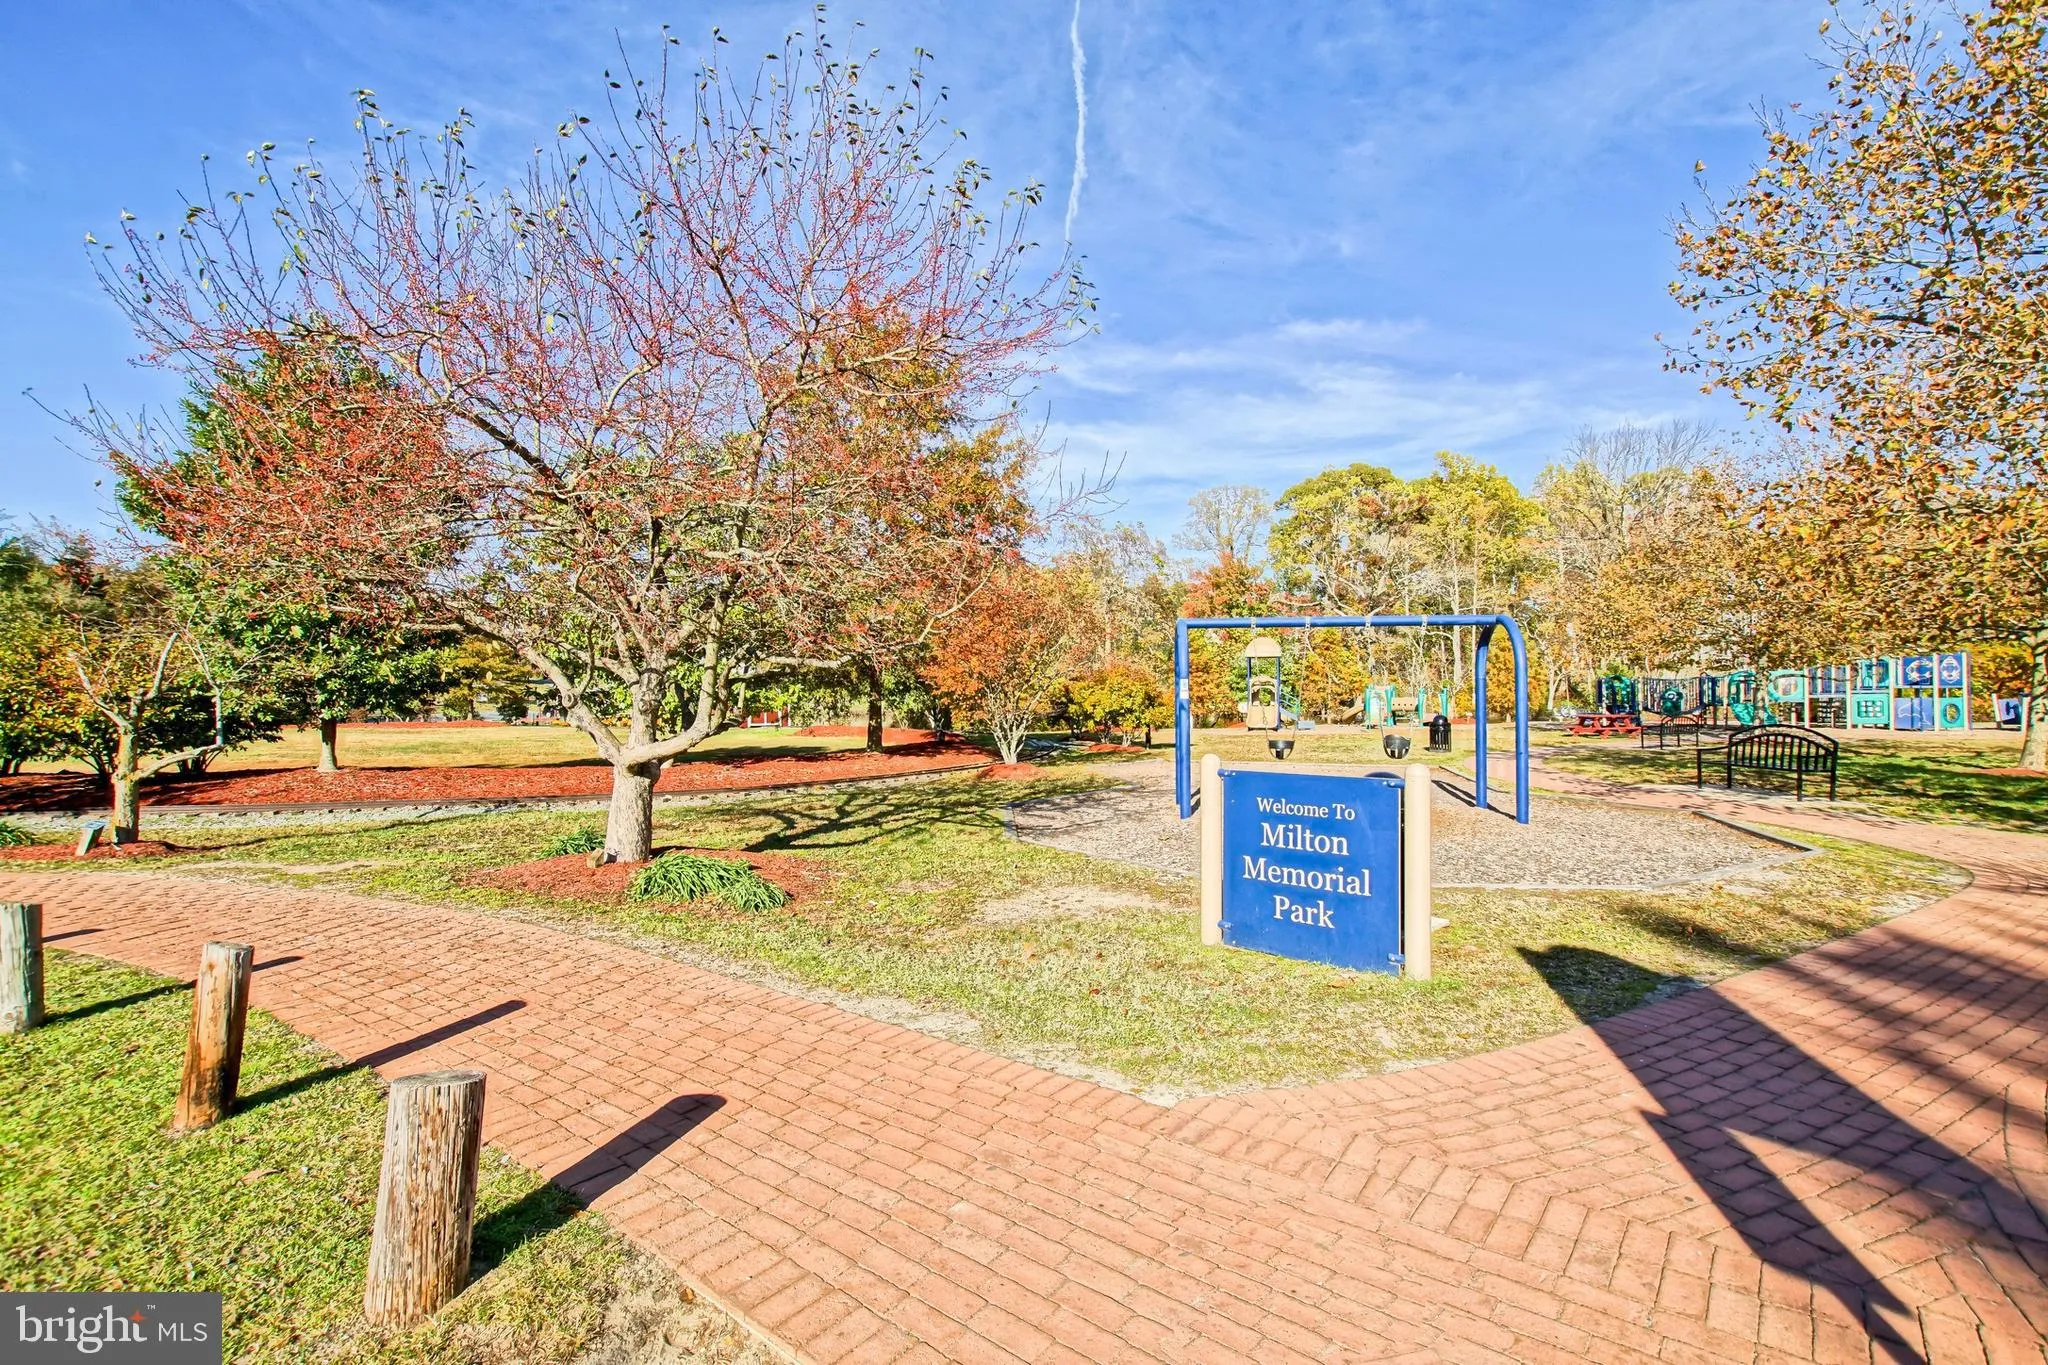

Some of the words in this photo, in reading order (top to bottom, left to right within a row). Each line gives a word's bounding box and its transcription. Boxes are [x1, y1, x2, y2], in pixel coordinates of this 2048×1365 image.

[1256, 797, 1328, 818] Welcome
[1332, 803, 1356, 821] To
[1260, 822, 1350, 856] Milton
[1242, 855, 1372, 897] Memorial
[1273, 894, 1336, 929] Park
